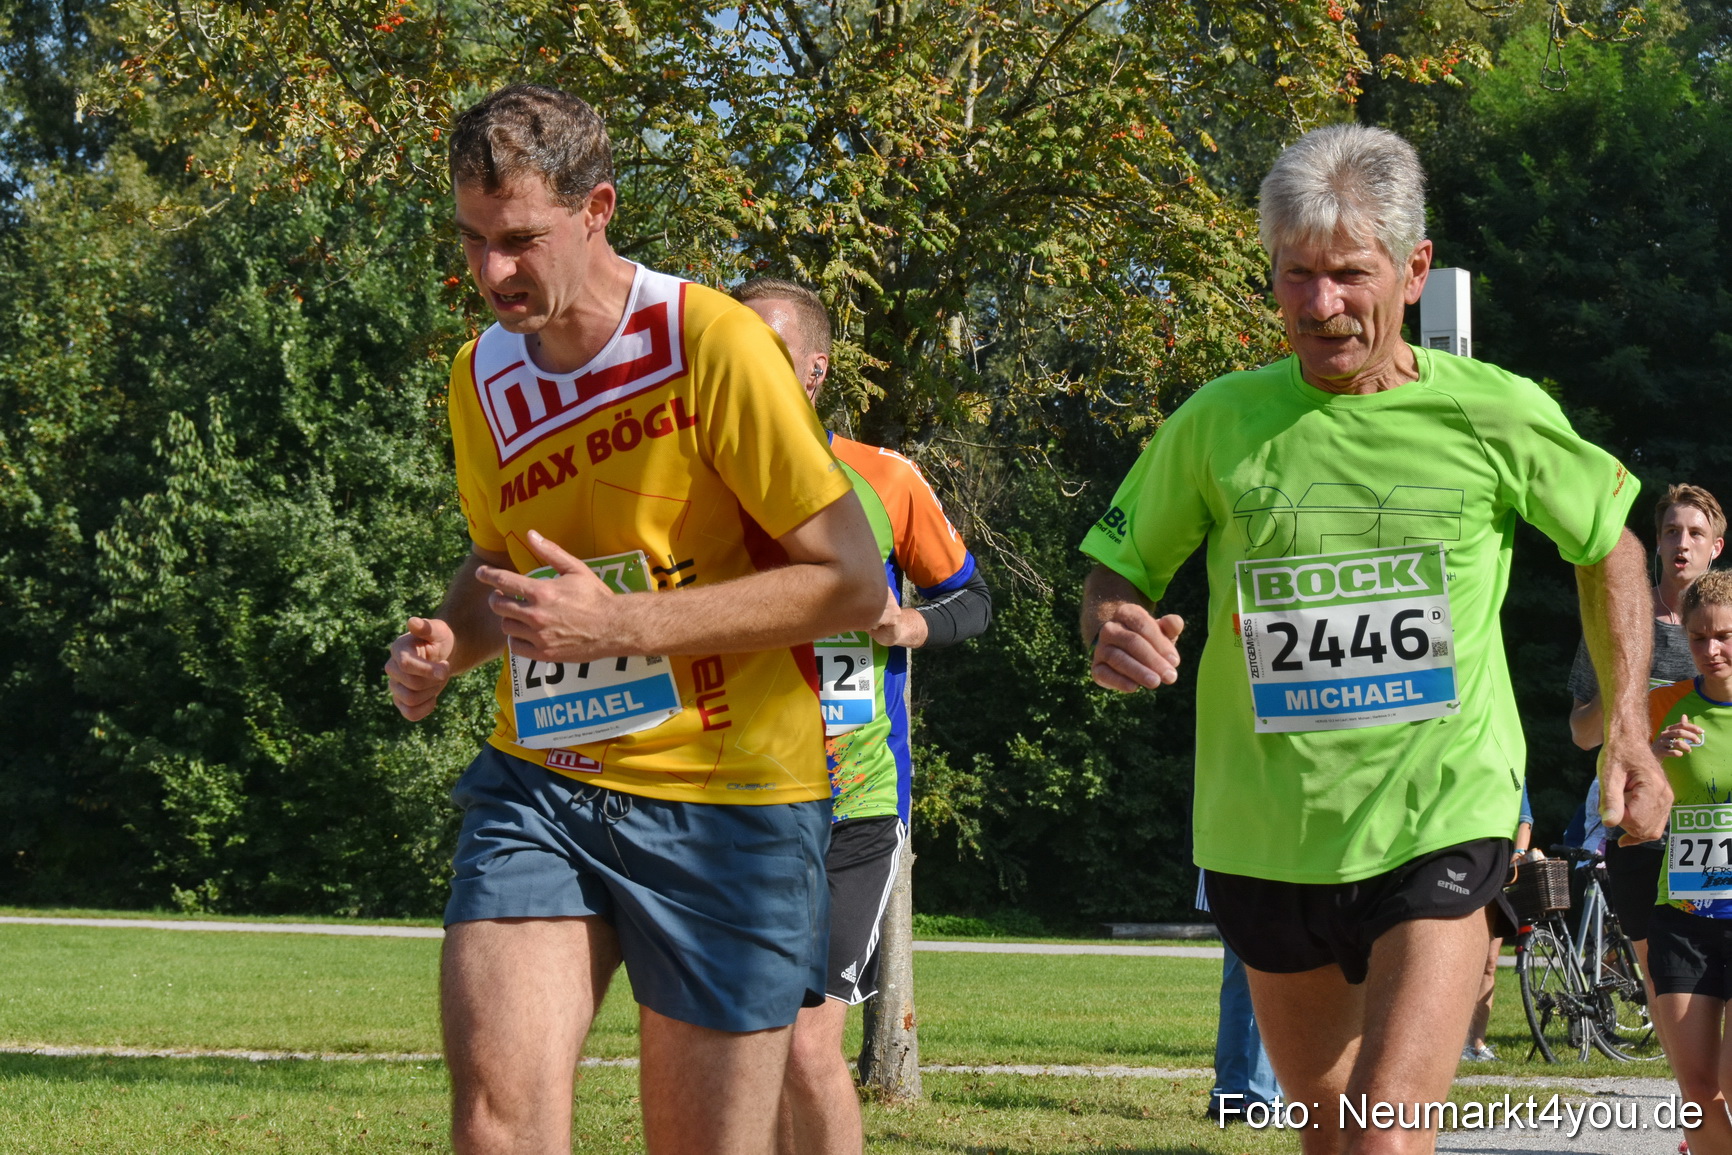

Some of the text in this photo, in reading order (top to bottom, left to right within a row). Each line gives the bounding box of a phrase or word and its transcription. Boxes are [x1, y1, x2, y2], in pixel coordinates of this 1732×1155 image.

[499, 397, 700, 513] MAX BÖGL
[1255, 552, 1430, 607] BOCK
[1431, 611, 1441, 621] D
[1266, 608, 1430, 673] 2446
[534, 690, 645, 730] MICHAEL
[1285, 680, 1423, 711] MICHAEL
[1679, 838, 1732, 866] 271
[1437, 879, 1471, 896] erima
